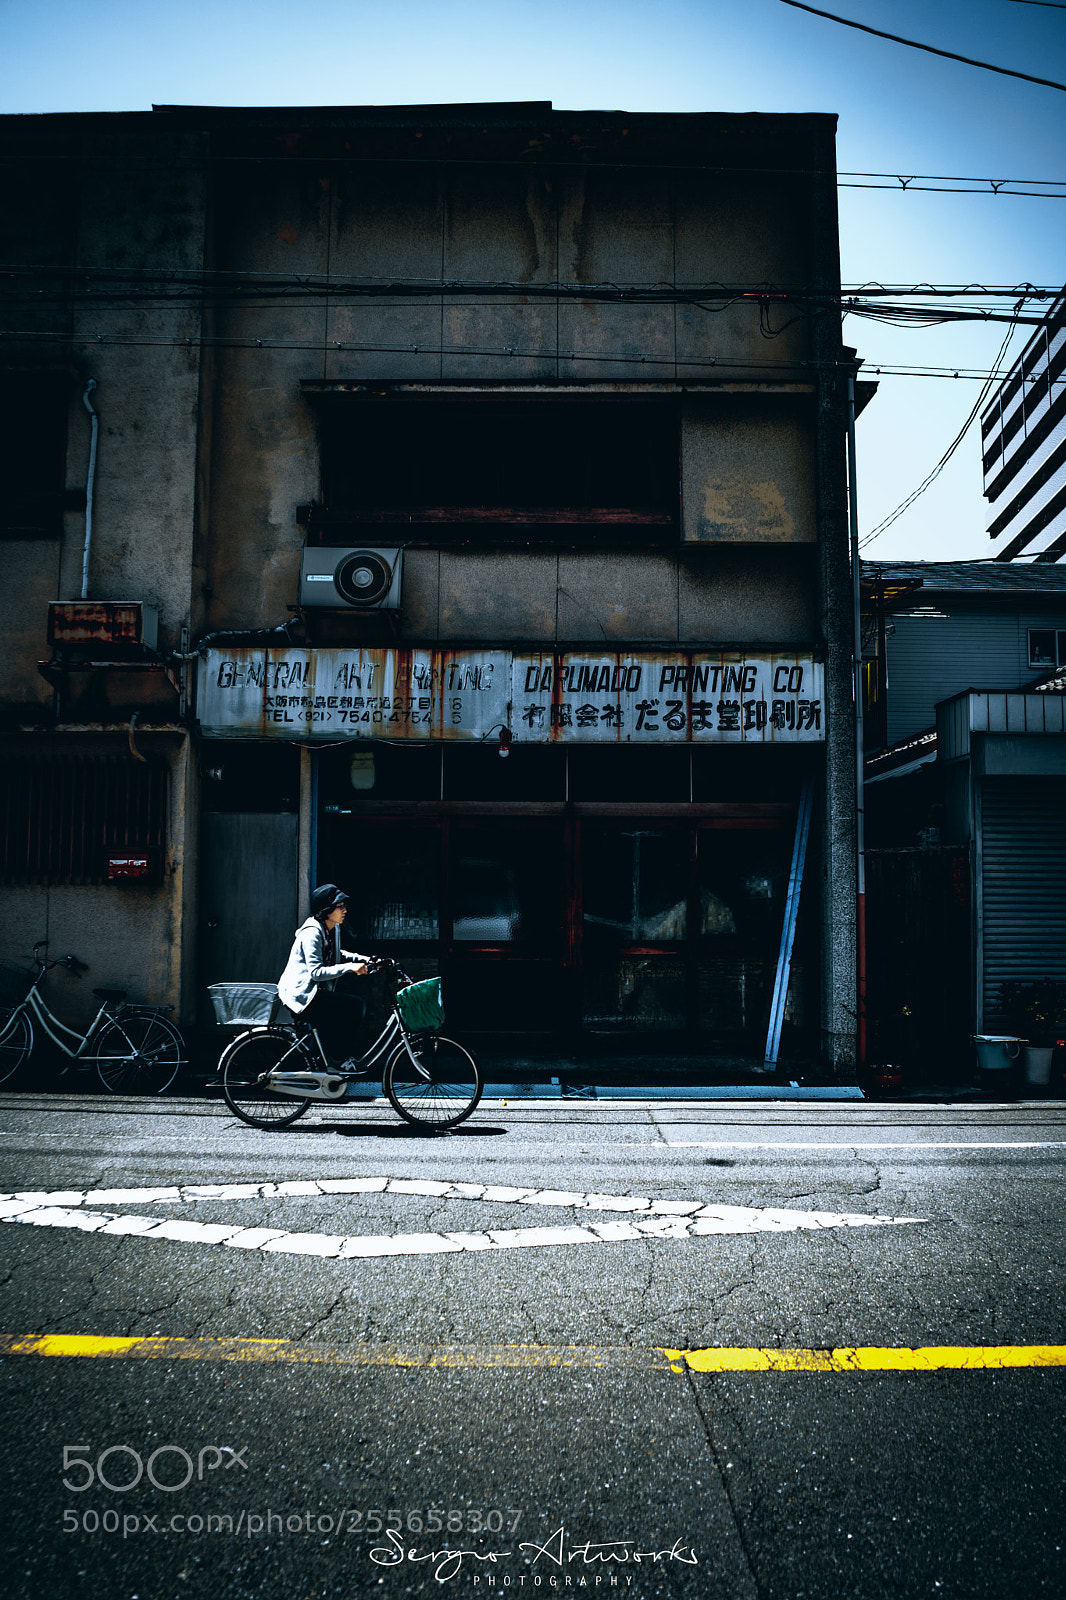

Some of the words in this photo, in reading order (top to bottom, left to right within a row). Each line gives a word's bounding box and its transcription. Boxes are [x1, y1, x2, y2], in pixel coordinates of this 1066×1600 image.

[217, 661, 316, 689] GENERAL
[334, 662, 380, 689] ART
[523, 665, 642, 693] DARUMADO
[658, 665, 758, 693] PRINTING
[773, 665, 806, 693] CO.
[521, 703, 625, 729] 有限会社
[634, 698, 822, 732] だるま堂印刷所
